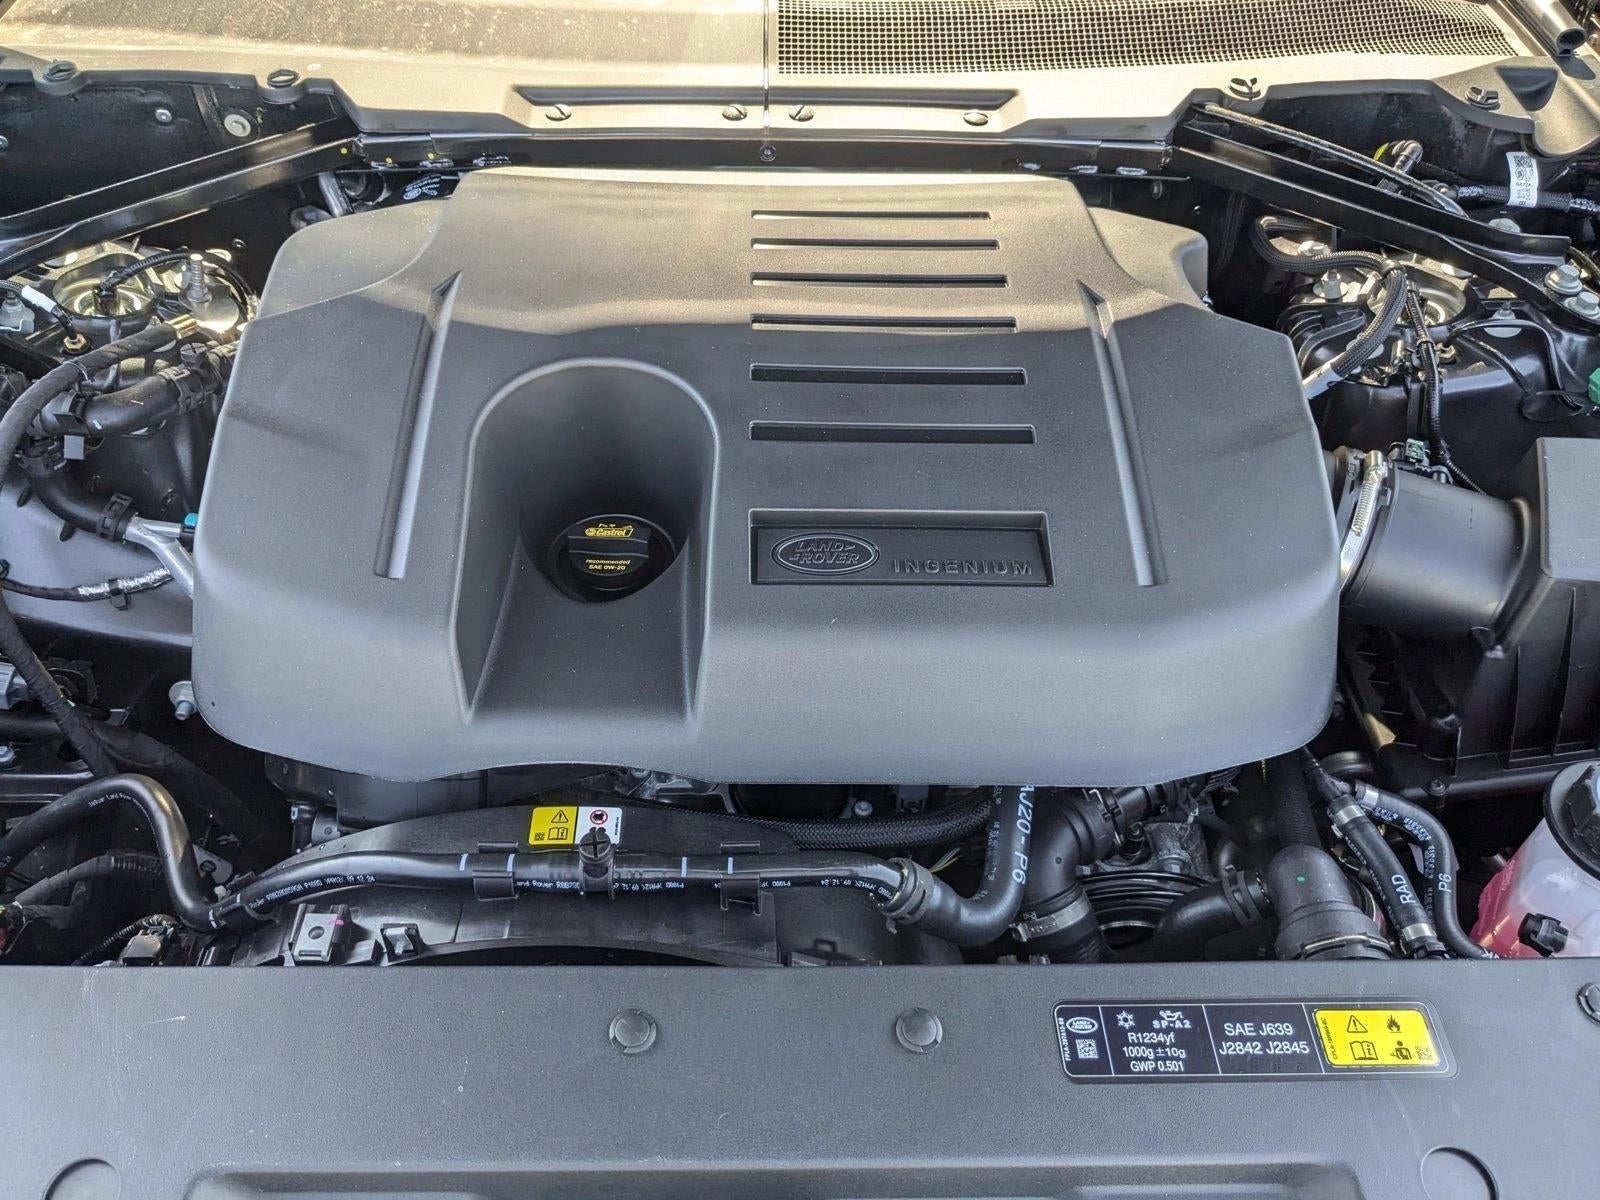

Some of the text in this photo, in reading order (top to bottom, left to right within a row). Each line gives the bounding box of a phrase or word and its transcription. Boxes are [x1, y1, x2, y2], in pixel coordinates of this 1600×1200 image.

[596, 528, 627, 536] Castrol
[795, 541, 844, 552] LAND
[799, 552, 860, 564] ROVER
[892, 559, 1033, 576] INGENIUM
[1391, 874, 1416, 904] RAD
[1438, 873, 1452, 893] P6
[1152, 1020, 1192, 1029] SP-A2
[1223, 1022, 1294, 1036] SAE J639
[1127, 1032, 1176, 1045] R1234yf
[1122, 1046, 1154, 1059] 1000g
[1219, 1041, 1309, 1055] J2842 J2845
[1130, 1060, 1184, 1072] GWP 0.501
